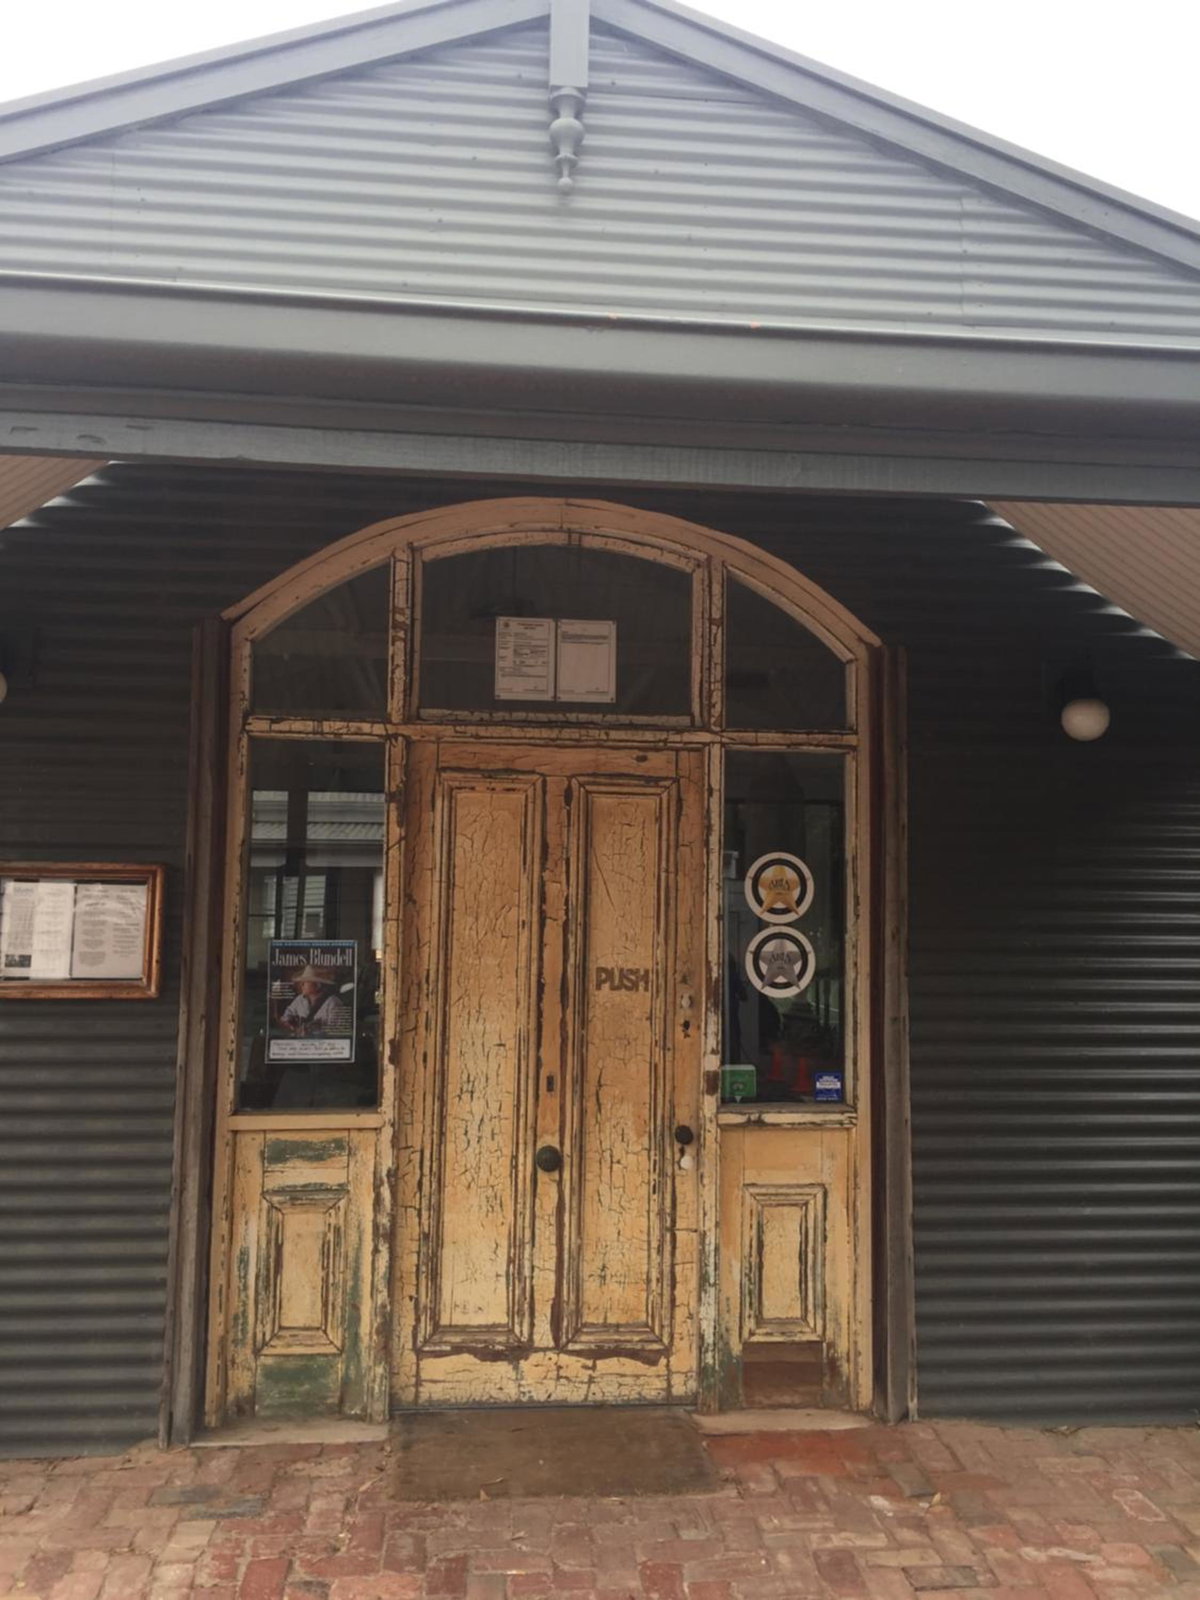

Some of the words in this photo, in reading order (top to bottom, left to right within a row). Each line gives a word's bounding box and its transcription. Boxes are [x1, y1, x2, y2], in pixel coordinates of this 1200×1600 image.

[272, 948, 308, 966] James
[310, 948, 353, 966] Blundell
[595, 966, 650, 992] PUSH
